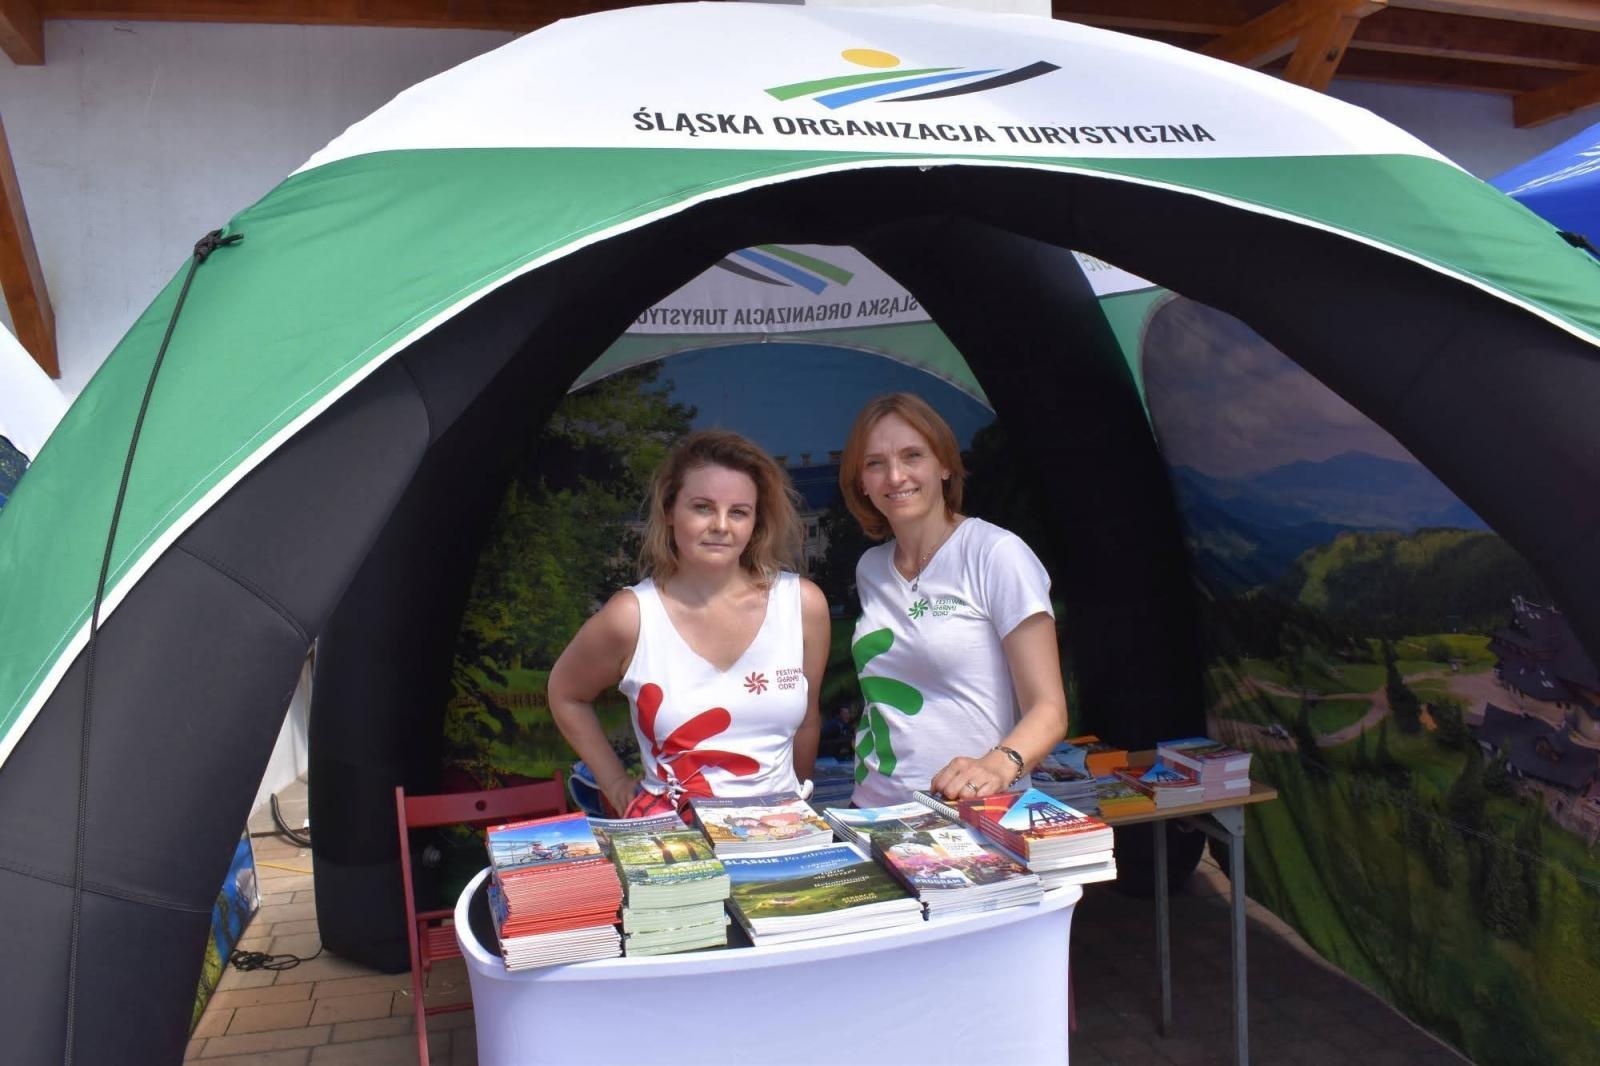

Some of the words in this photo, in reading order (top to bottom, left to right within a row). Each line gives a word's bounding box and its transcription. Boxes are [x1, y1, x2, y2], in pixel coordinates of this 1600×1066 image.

[633, 107, 763, 137] ŚLĄSKA
[776, 115, 994, 144] ORGANIZACJA
[998, 123, 1216, 145] TURYSTYCZNA
